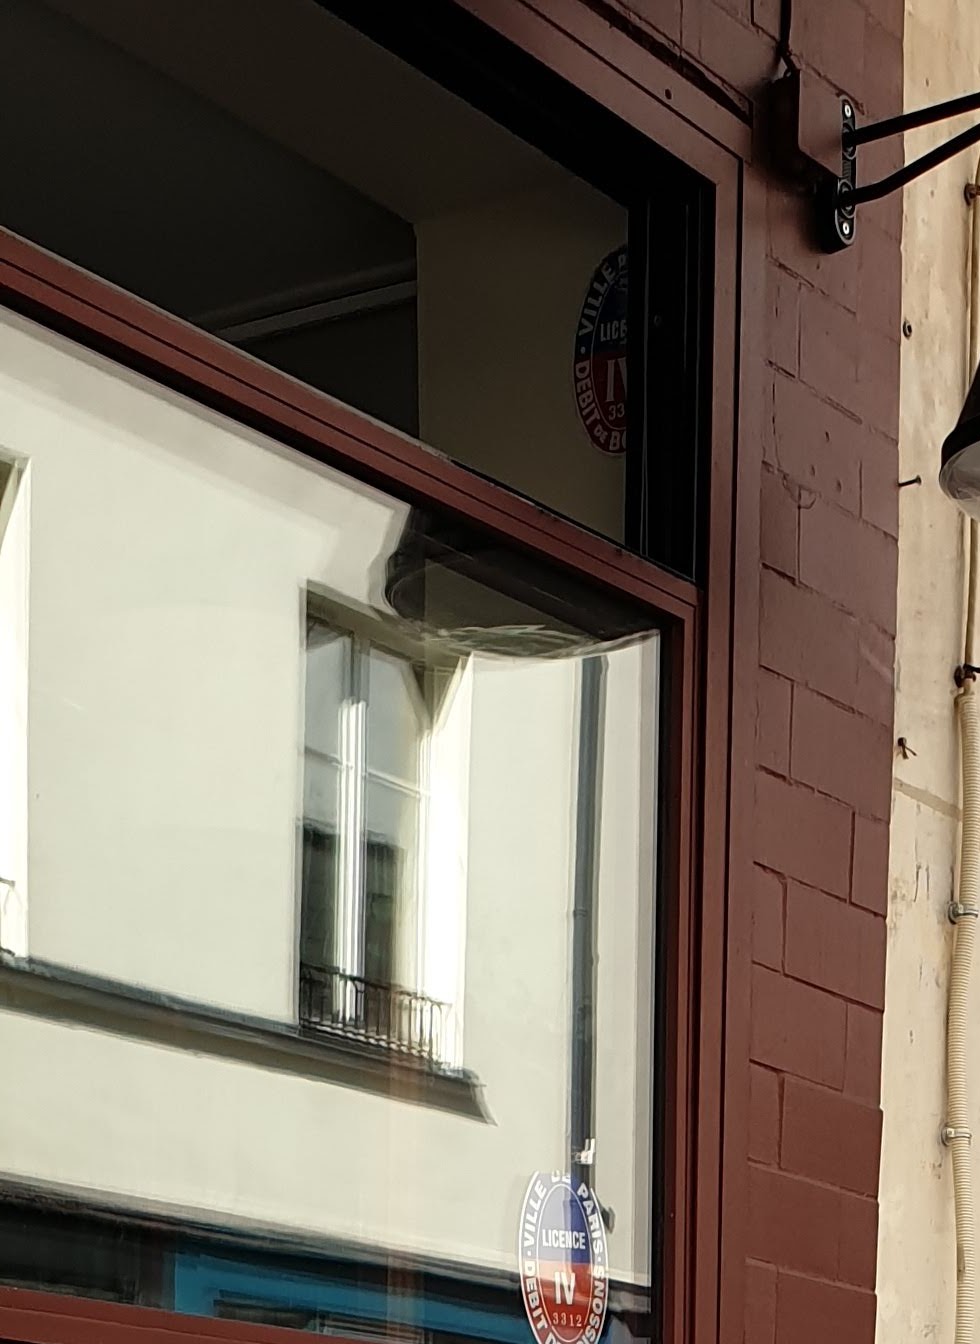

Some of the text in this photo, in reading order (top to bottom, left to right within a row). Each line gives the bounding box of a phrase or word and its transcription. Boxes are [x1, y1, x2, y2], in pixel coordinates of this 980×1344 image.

[578, 262, 616, 337] VILLE
[600, 319, 628, 342] LICE
[575, 359, 601, 426] DEBIT
[523, 1180, 547, 1247] VILLE
[577, 1182, 604, 1255] PARIS
[541, 1228, 586, 1250] LICENCE
[524, 1260, 548, 1330] DEBIT
[554, 1271, 576, 1305] IV
[552, 1312, 582, 1327] 3312
